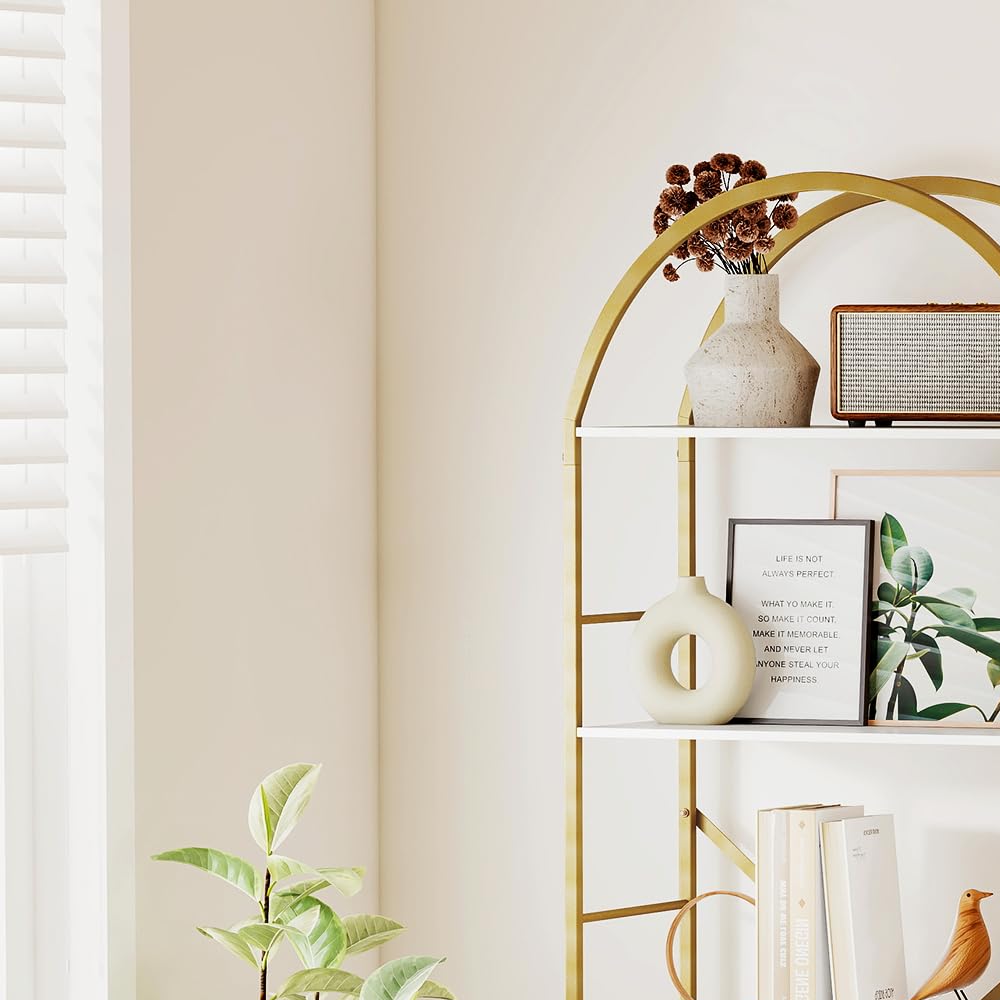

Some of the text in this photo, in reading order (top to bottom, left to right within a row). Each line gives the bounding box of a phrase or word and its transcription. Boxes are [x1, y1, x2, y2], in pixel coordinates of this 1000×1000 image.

[775, 555, 823, 563] LIFE IS NOT
[761, 570, 835, 578] ALWAYS PERFECT
[761, 600, 784, 608] WHAT
[786, 600, 798, 608] YO
[800, 600, 823, 608] MAKE
[757, 615, 770, 623] SO
[771, 615, 795, 623] MAKE
[796, 615, 804, 623] IT
[752, 630, 776, 638] MAKE
[777, 630, 785, 638] IT
[763, 645, 829, 654] AND NEVER LET
[788, 661, 814, 669] STEAL
[815, 661, 840, 669] YOUR
[770, 675, 818, 684] HAPPINESS
